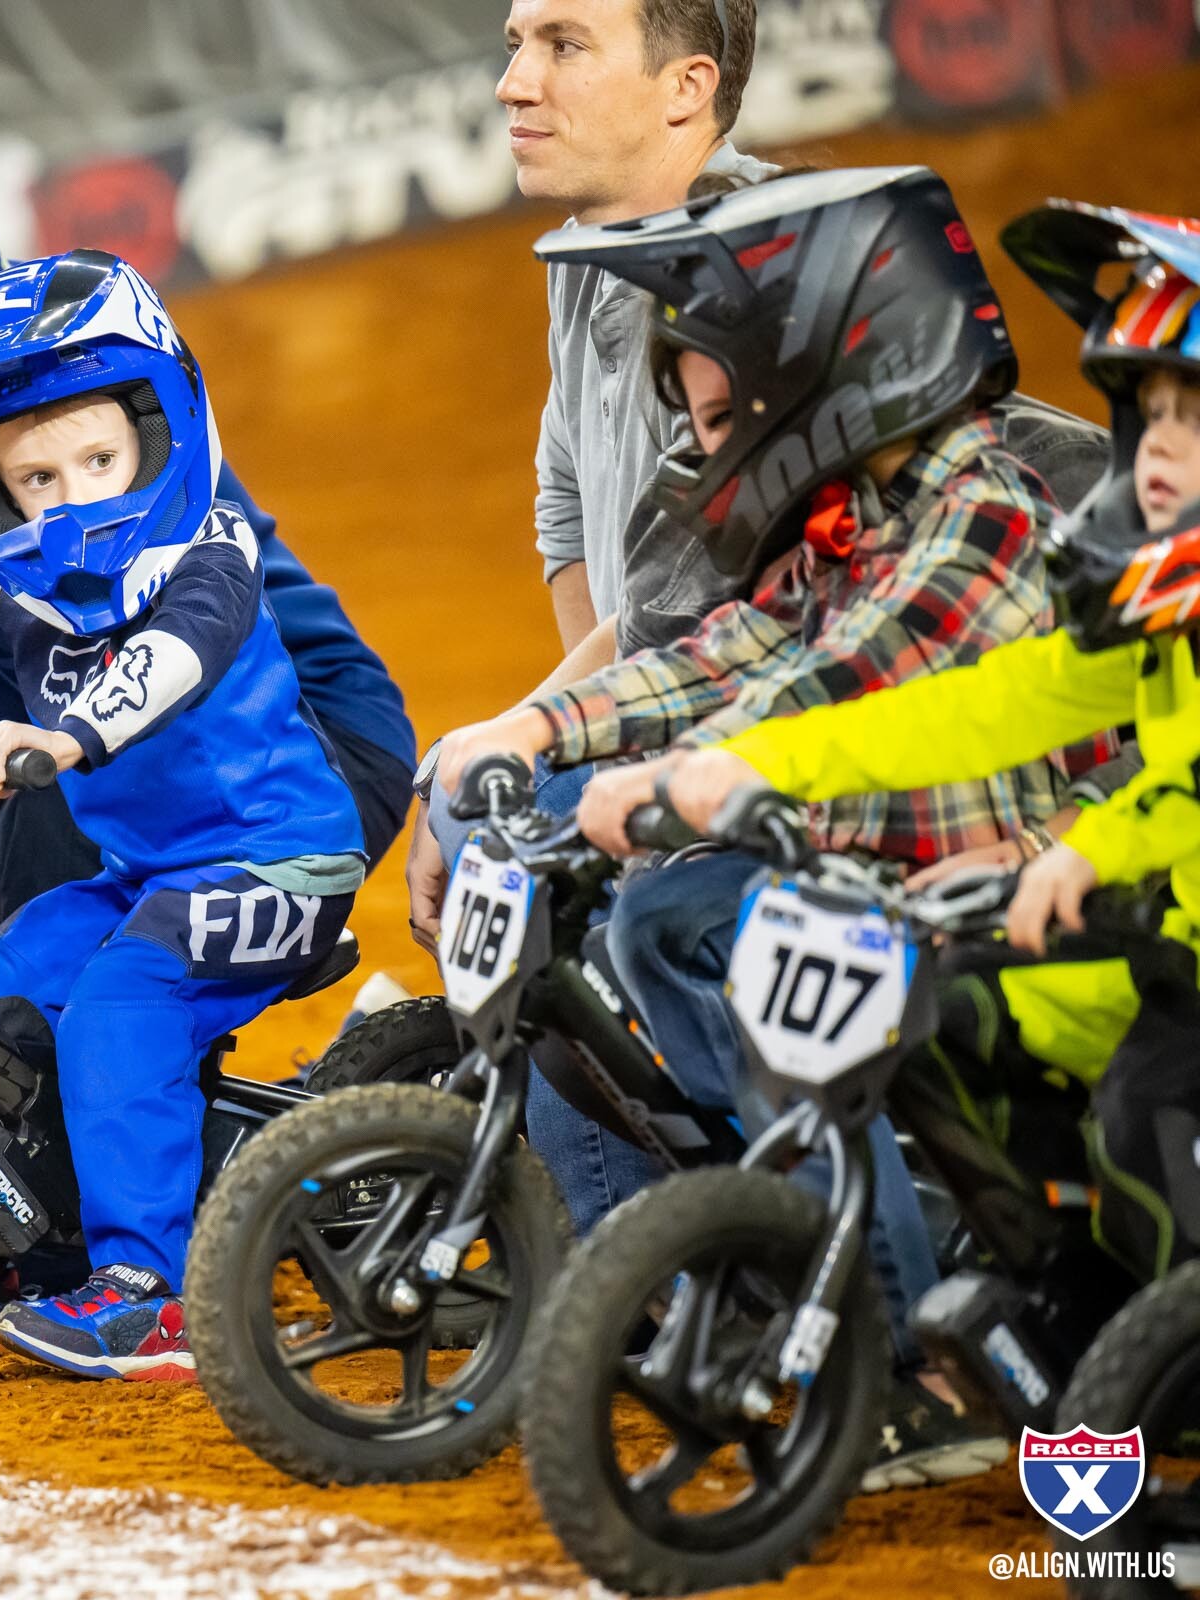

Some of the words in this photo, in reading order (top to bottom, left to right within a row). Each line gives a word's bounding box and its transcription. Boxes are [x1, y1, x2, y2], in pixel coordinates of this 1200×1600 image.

[189, 885, 322, 963] FOX
[449, 889, 512, 979] 108
[761, 943, 884, 1043] 107
